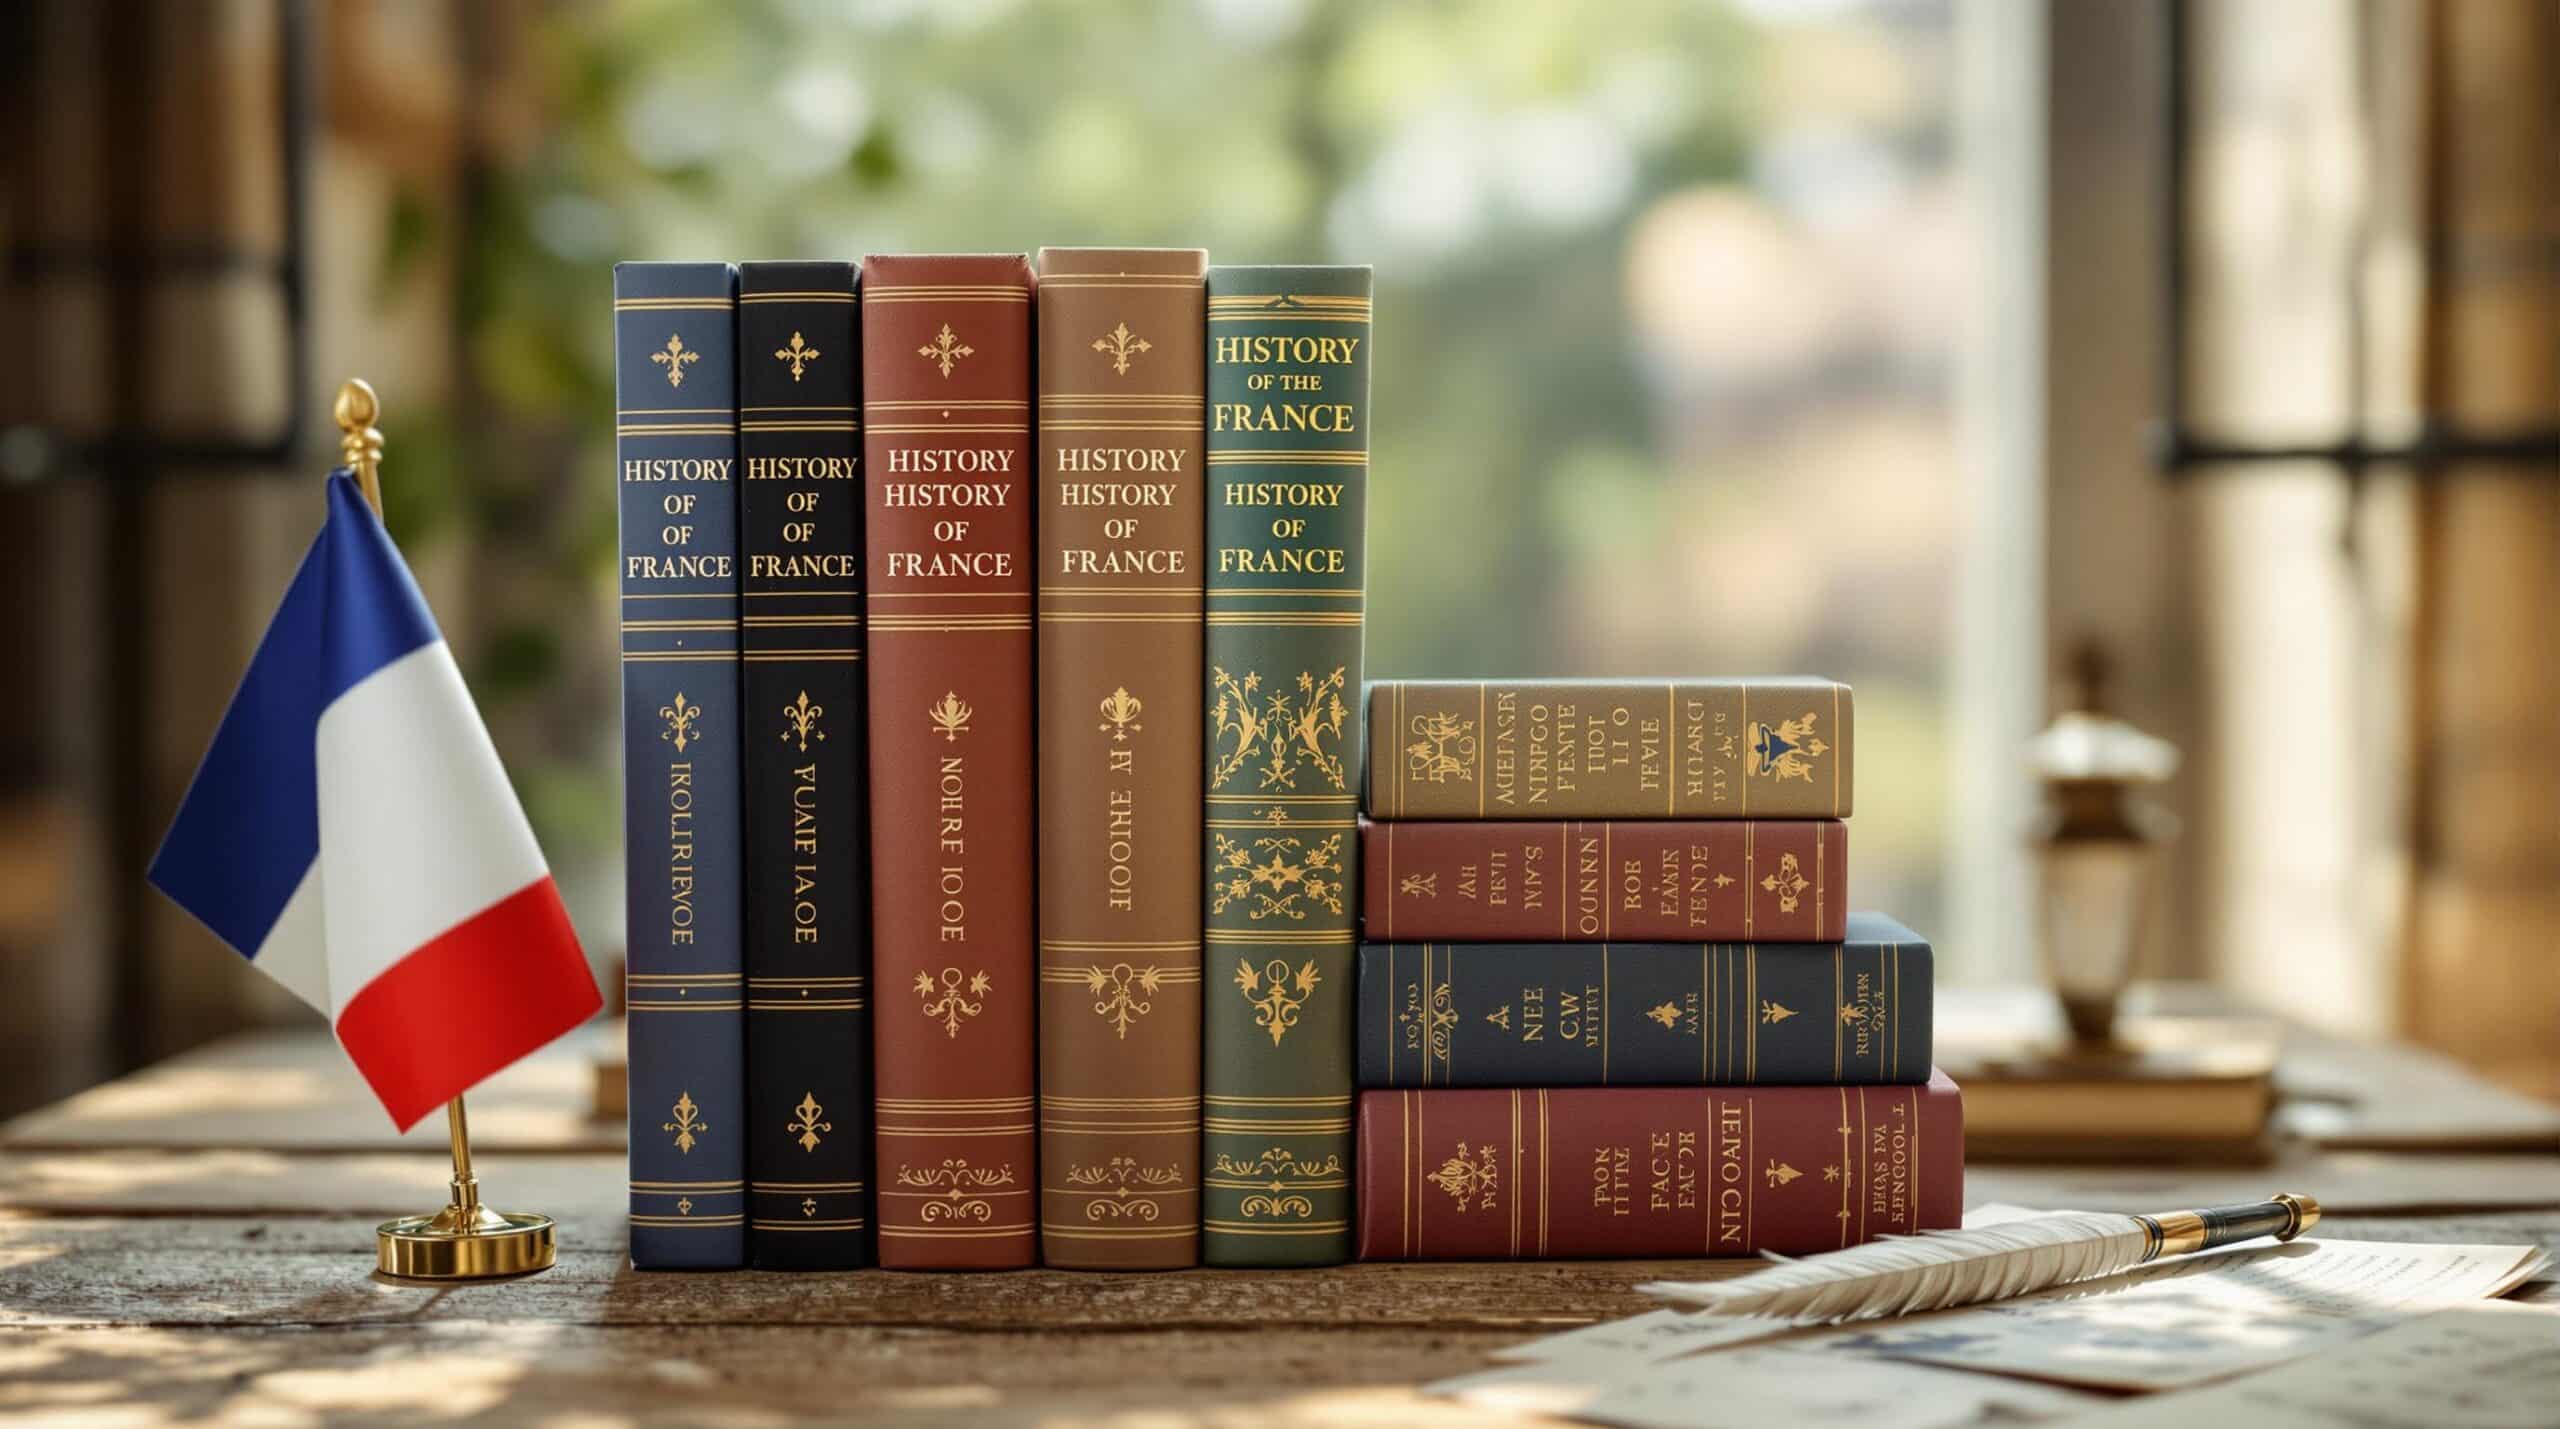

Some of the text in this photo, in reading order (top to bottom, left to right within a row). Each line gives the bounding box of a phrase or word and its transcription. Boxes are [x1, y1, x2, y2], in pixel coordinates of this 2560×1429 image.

[1215, 336, 1360, 364] HISTORY
[1247, 374, 1323, 391] OF THE
[1213, 404, 1355, 433] FRANCE
[624, 457, 734, 482] HISTORY
[747, 457, 858, 481] HISTORY
[888, 448, 1016, 473] HISTORY
[1057, 448, 1187, 472] HISTORY
[663, 494, 697, 515] OF
[786, 492, 820, 513] OF
[884, 483, 1012, 508] HISTORY
[1061, 483, 1177, 507] HISTORY
[1224, 483, 1345, 507] HISTORY
[662, 525, 694, 546] OF
[782, 522, 816, 543] OF
[933, 520, 970, 542] OF
[1104, 519, 1139, 539] OF
[1272, 518, 1307, 539] OF
[627, 555, 732, 579] FRANCE
[750, 554, 856, 578] FRANCE
[886, 552, 1013, 577] FRANCE
[1062, 550, 1186, 575] FRANCE
[1219, 548, 1346, 574] FRANCE
